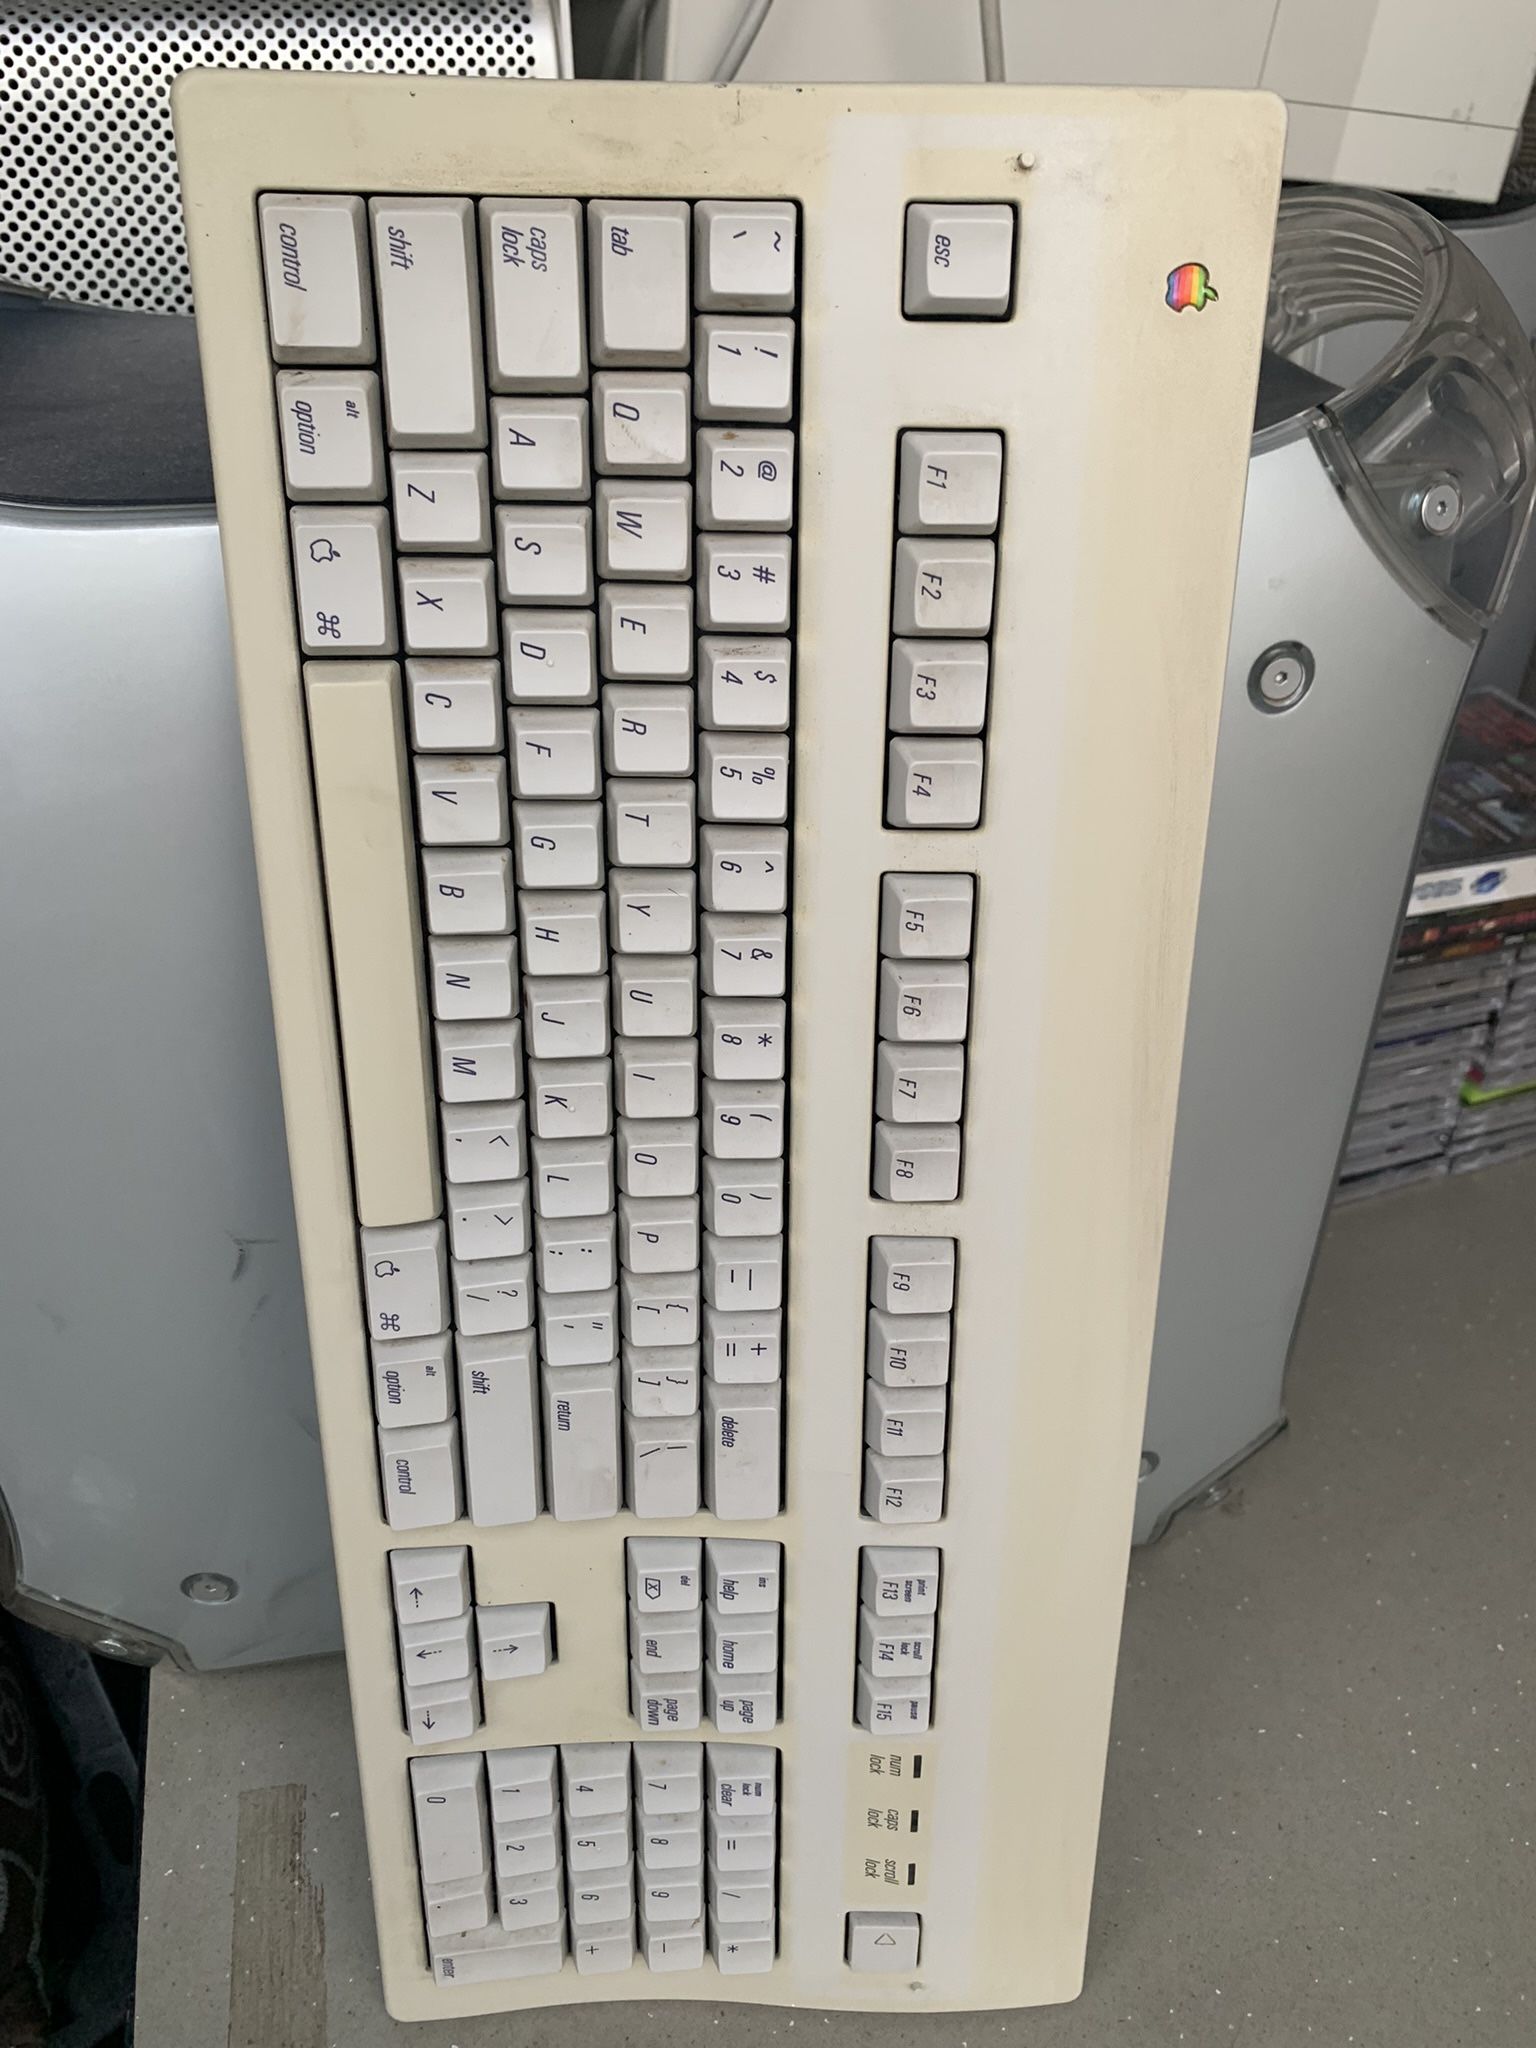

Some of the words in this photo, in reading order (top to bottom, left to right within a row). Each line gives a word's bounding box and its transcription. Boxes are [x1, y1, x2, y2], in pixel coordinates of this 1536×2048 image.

[387, 225, 414, 271] shift
[501, 225, 526, 268] lock
[525, 226, 548, 273] caps
[610, 225, 634, 257] tab
[278, 222, 308, 292] control
[934, 234, 951, 268] esc
[717, 344, 742, 357] 1
[754, 346, 779, 359] !
[345, 399, 361, 419] alt
[612, 401, 640, 422] Q
[291, 399, 321, 455] option
[508, 427, 537, 447] A
[720, 459, 745, 478] 2
[757, 460, 778, 482] @
[926, 464, 948, 490] F1
[407, 483, 436, 504] Z
[615, 510, 643, 540] W
[514, 536, 542, 556] S
[716, 564, 742, 581] 3
[752, 565, 776, 585] #
[920, 571, 943, 601] F2
[415, 590, 444, 612] X
[620, 616, 647, 635] E
[519, 641, 547, 661] D
[720, 670, 744, 686] 4
[753, 670, 778, 684] $
[915, 673, 937, 701] F3
[424, 692, 453, 709] C
[621, 717, 647, 736] R
[525, 741, 552, 758] F
[719, 765, 743, 781] 5
[751, 766, 776, 786] %
[912, 772, 933, 798] F4
[431, 790, 458, 806] V
[624, 813, 650, 828] T
[530, 835, 557, 851] G
[719, 860, 743, 874] 6
[764, 860, 775, 874] ^
[438, 883, 465, 899] B
[626, 903, 651, 918] Y
[904, 909, 925, 933] F5
[534, 926, 560, 943] H
[720, 948, 742, 961] 7
[749, 947, 774, 961] &
[445, 972, 471, 990] N
[629, 989, 654, 1005] U
[902, 994, 922, 1018] F6
[540, 1011, 566, 1026] J
[720, 1033, 743, 1046] 8
[451, 1056, 477, 1076] M
[898, 1077, 917, 1100] F7
[544, 1094, 568, 1109] K
[719, 1113, 742, 1126] 9
[749, 1113, 773, 1122] (
[488, 1134, 510, 1147] <
[634, 1152, 658, 1166] O
[895, 1158, 915, 1179] F8
[546, 1174, 570, 1183] L
[720, 1192, 742, 1205] 0
[749, 1192, 773, 1201] )
[493, 1214, 514, 1226] >
[636, 1231, 660, 1244] P
[548, 1248, 564, 1257] ;
[580, 1247, 593, 1255] :
[892, 1272, 911, 1292] F9
[465, 1293, 490, 1303] /
[496, 1289, 519, 1298] ?
[636, 1305, 661, 1315] [
[665, 1303, 689, 1313] {
[726, 1342, 736, 1357] =
[750, 1342, 768, 1357] +
[889, 1347, 908, 1371] F10
[425, 1365, 437, 1377] alt
[665, 1375, 689, 1385] }
[383, 1370, 406, 1405] option
[471, 1370, 491, 1395] shift
[637, 1376, 662, 1387] ]
[556, 1399, 572, 1432] return
[721, 1415, 739, 1448] delete
[886, 1418, 904, 1437] F11
[639, 1447, 661, 1459] \
[395, 1458, 417, 1496] control
[885, 1487, 903, 1508] F12
[719, 1578, 740, 1601] help
[881, 1580, 899, 1601] F13
[645, 1638, 663, 1659] end
[722, 1639, 739, 1670] home
[878, 1642, 895, 1662] F14
[646, 1698, 663, 1726] down
[662, 1697, 679, 1723] page
[719, 1699, 735, 1713] up
[738, 1698, 754, 1724] page
[875, 1702, 893, 1721] F15
[869, 1753, 886, 1776] lock
[889, 1753, 902, 1777] num
[575, 1784, 594, 1793] 4
[647, 1782, 667, 1791] 7
[720, 1783, 737, 1808] clear
[426, 1795, 447, 1805] 0
[866, 1807, 884, 1829] lock
[883, 1808, 899, 1832] caps
[505, 1843, 526, 1853] 2
[576, 1839, 596, 1849] 5
[650, 1837, 669, 1846] 8
[727, 1839, 736, 1851] =
[864, 1858, 881, 1879] lock
[883, 1858, 900, 1886] scroll
[508, 1897, 529, 1907] 3
[580, 1893, 600, 1902] 6
[650, 1890, 670, 1899] 9
[721, 1890, 742, 1900] /
[585, 1943, 600, 1956] +
[441, 1957, 456, 1979] enter
